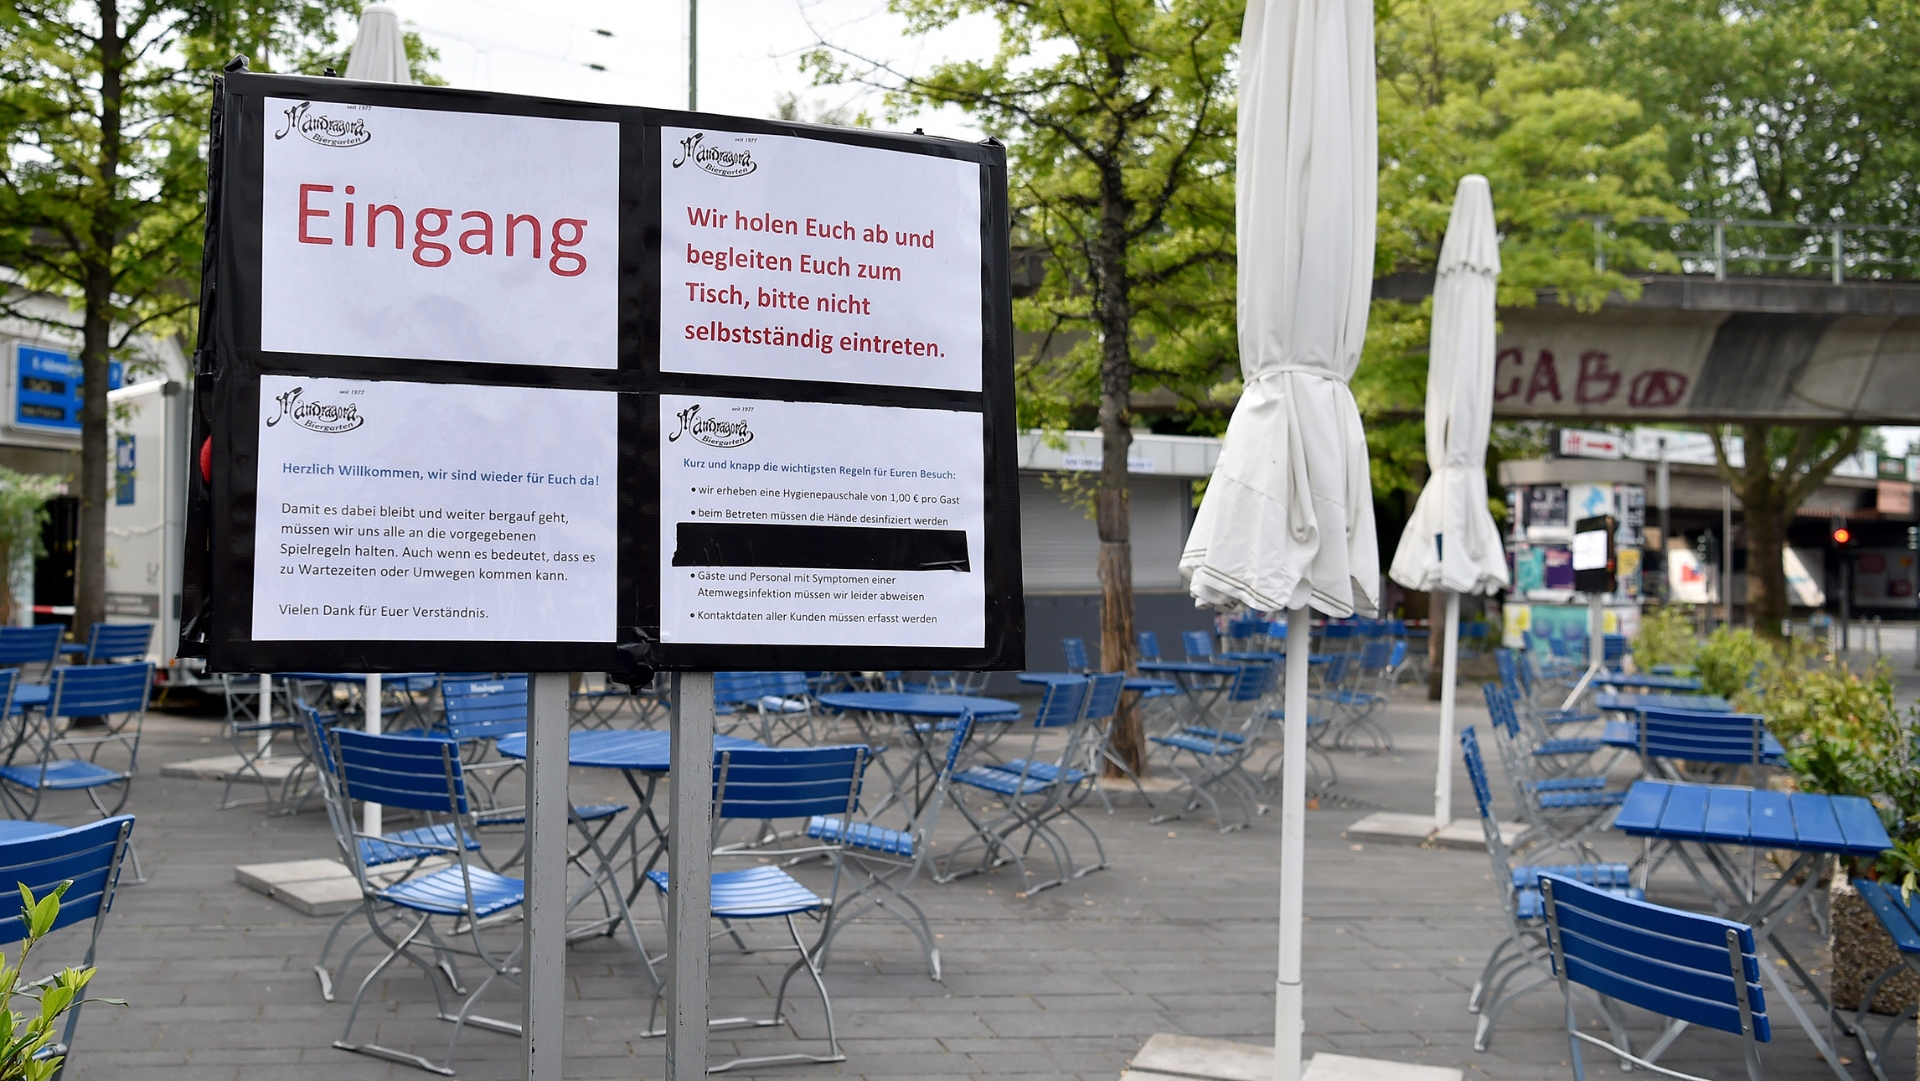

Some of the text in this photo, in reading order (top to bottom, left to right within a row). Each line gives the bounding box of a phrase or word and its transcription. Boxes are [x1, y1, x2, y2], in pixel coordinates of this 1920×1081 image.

[275, 101, 371, 142] Mandragora
[312, 133, 361, 145] Biergarten
[673, 132, 757, 170] Mandragora
[705, 163, 748, 175] Biergarten
[299, 183, 588, 277] Eingang
[687, 206, 934, 249] Wir holen Euch ab und
[687, 243, 901, 282] begleiten Euch zum
[685, 282, 870, 315] Tisch, bitte nicht
[685, 321, 944, 358] selbstständig eintreten.
[266, 386, 364, 427] Mandragora
[305, 419, 354, 431] Biergarten
[668, 404, 754, 442] Mandragora
[701, 435, 745, 446] Biergarten
[283, 463, 599, 486] Herzlich Willkommen, wir sind wieder für Euch da!
[683, 458, 956, 480] Kurz und knapp die wichtigsten Regeln für Euren Besuch:
[698, 485, 714, 494] wir
[716, 486, 757, 496] erheben
[760, 488, 780, 497] eine
[783, 488, 868, 501] Hygienepauschale
[891, 493, 911, 503] 1,00
[913, 494, 919, 503] €
[921, 496, 937, 505] pro
[939, 495, 960, 505] Gast
[282, 503, 568, 525] Damit es dabei bleibt und weiter bergauf geht,
[699, 508, 948, 526] beim Betreten müssen die Hände desinfiziert werden
[281, 523, 536, 543] müssen wir uns alle an die vorgegebenen
[280, 543, 595, 563] Spielregeln halten. Auch wenn es bedeutet, dass es
[280, 564, 568, 581] zu Wartezeiten oder Umwegen kommen kann.
[698, 571, 725, 581] Gäste
[729, 572, 747, 581] und
[750, 572, 791, 582] Personal
[794, 573, 809, 582] mit
[812, 574, 869, 585] Symptomen
[697, 587, 924, 601] Atemwegsinfektion müssen wir leider abweisen
[279, 604, 489, 618] Vielen Dank für Euer Verständnis.
[698, 611, 937, 624] Kontaktdaten aller Kunden müssen erfasst werden
